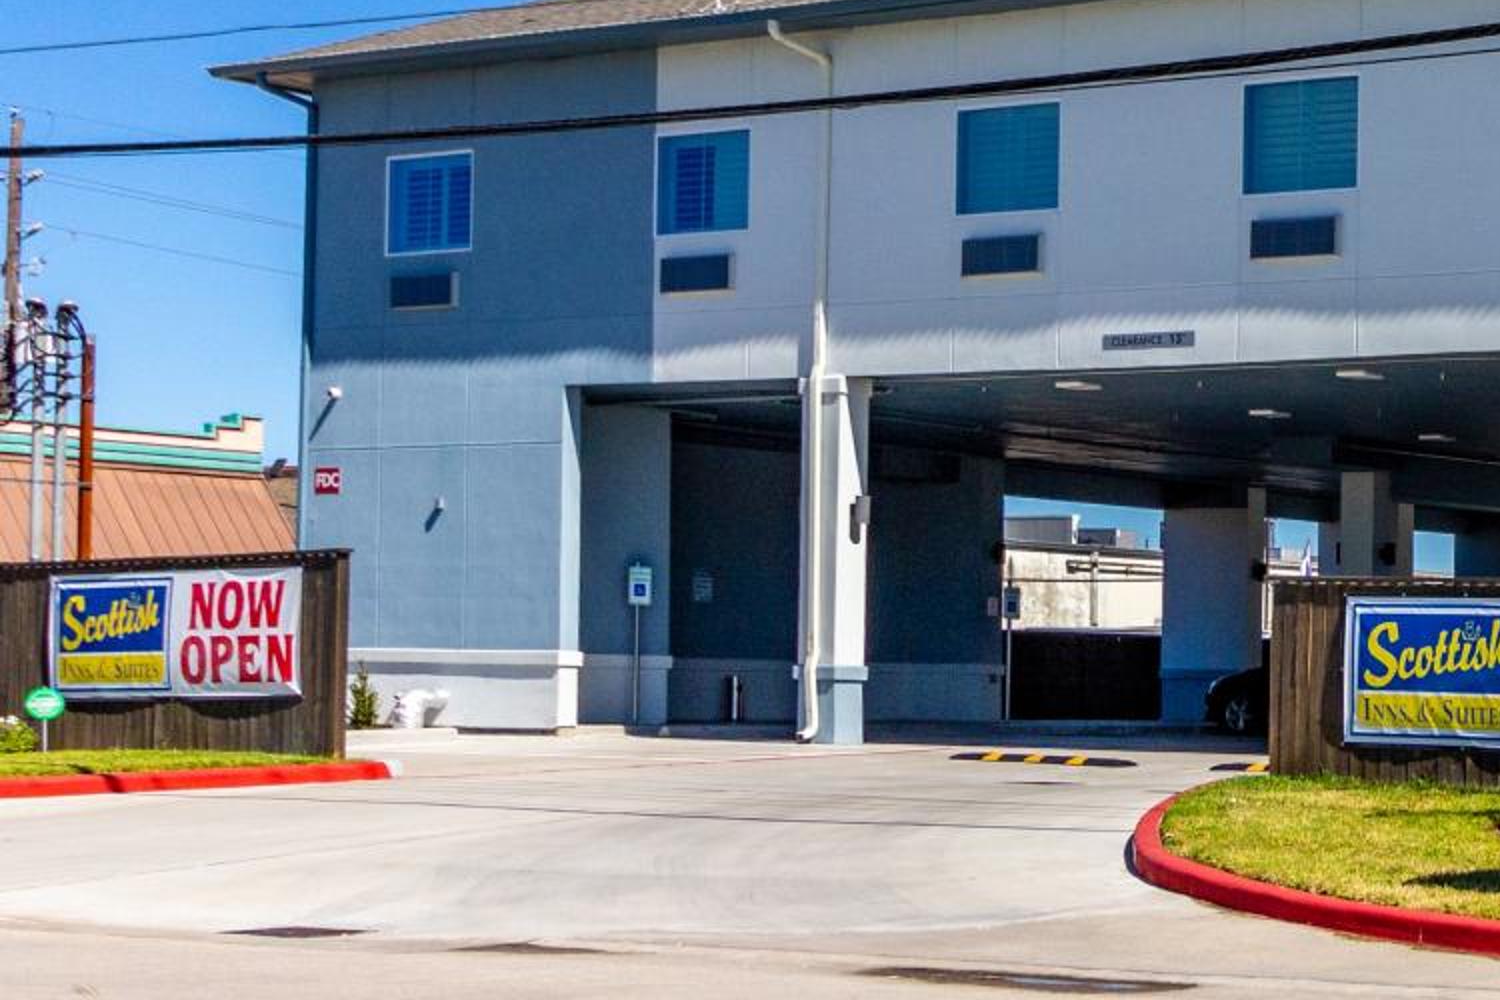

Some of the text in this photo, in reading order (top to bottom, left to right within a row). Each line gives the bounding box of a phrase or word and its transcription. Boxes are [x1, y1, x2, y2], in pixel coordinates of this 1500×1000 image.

[315, 473, 340, 489] FDC
[62, 590, 159, 651] Scottish
[189, 580, 285, 630] NOW
[180, 634, 293, 685] OPEN
